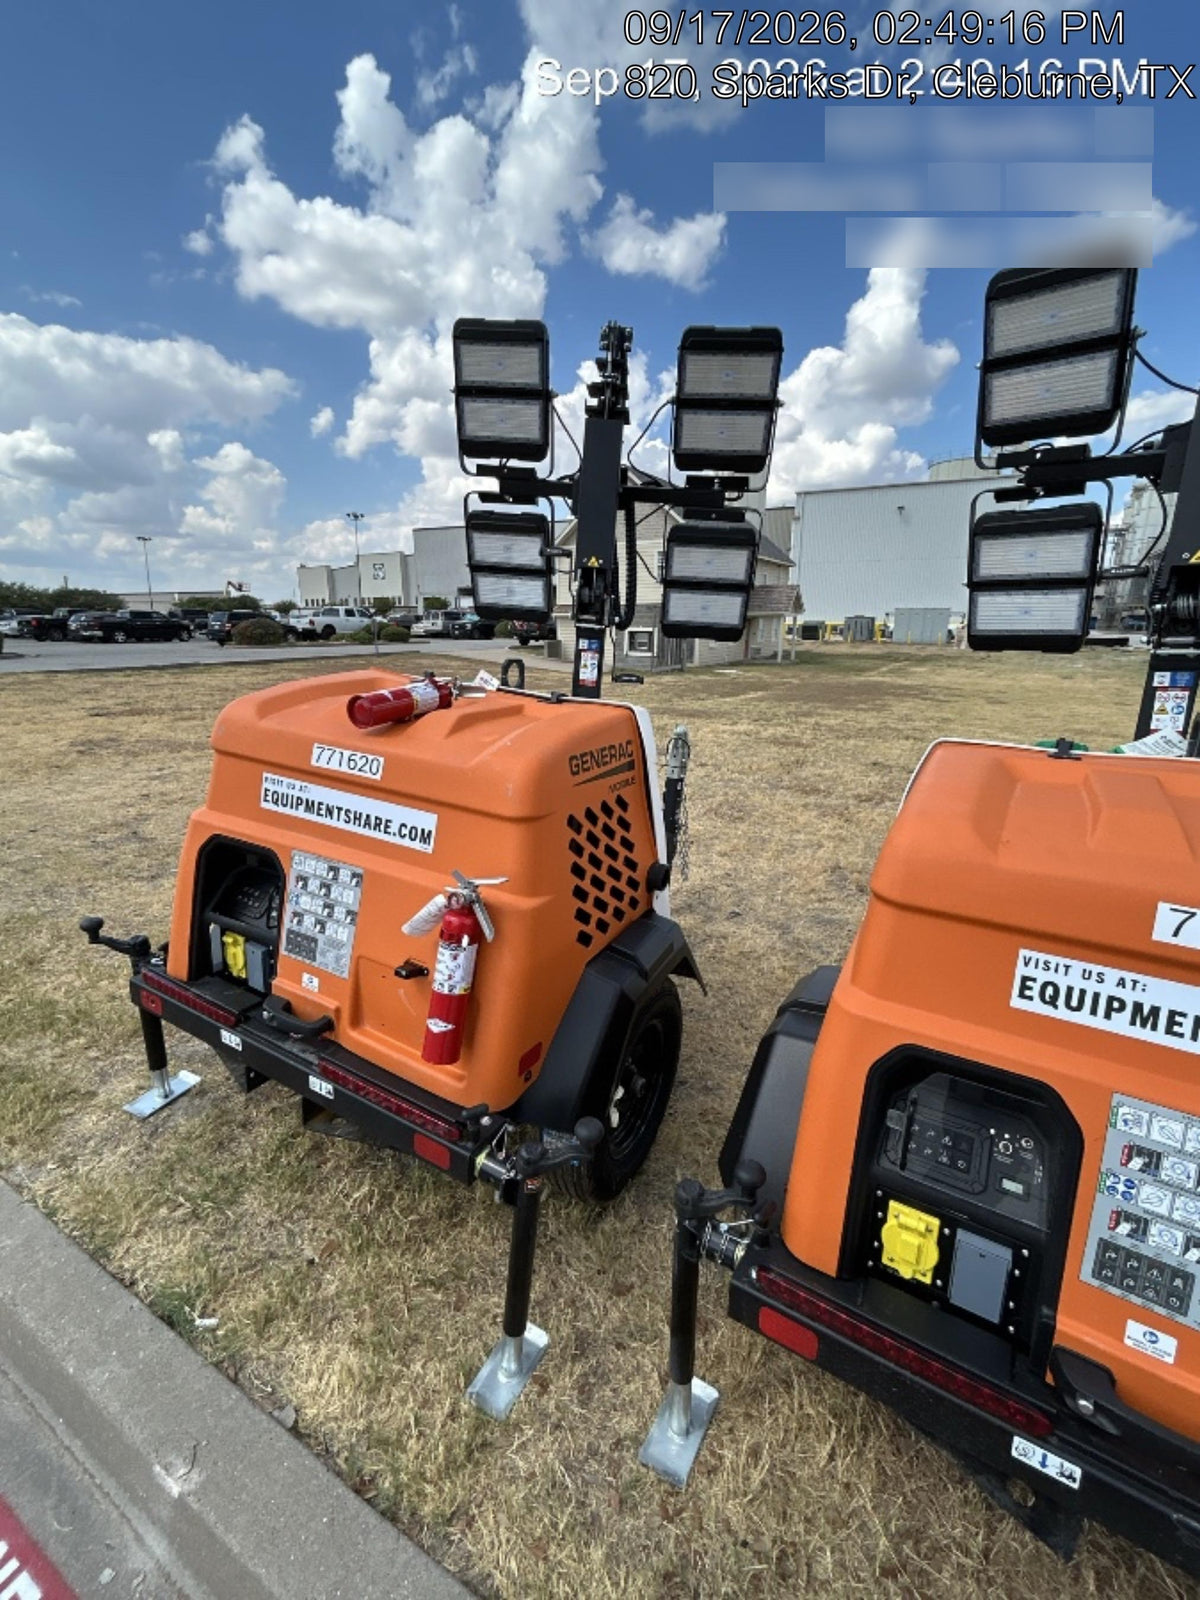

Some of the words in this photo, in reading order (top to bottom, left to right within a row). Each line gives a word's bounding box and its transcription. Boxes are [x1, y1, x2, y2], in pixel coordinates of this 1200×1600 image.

[315, 746, 382, 776] 771620
[568, 739, 634, 777] GENERAC
[262, 787, 433, 847] EQUIPMENTSHARE.COM
[1023, 955, 1073, 977] VISIT
[1081, 968, 1105, 984] US
[1115, 976, 1148, 993] AT:
